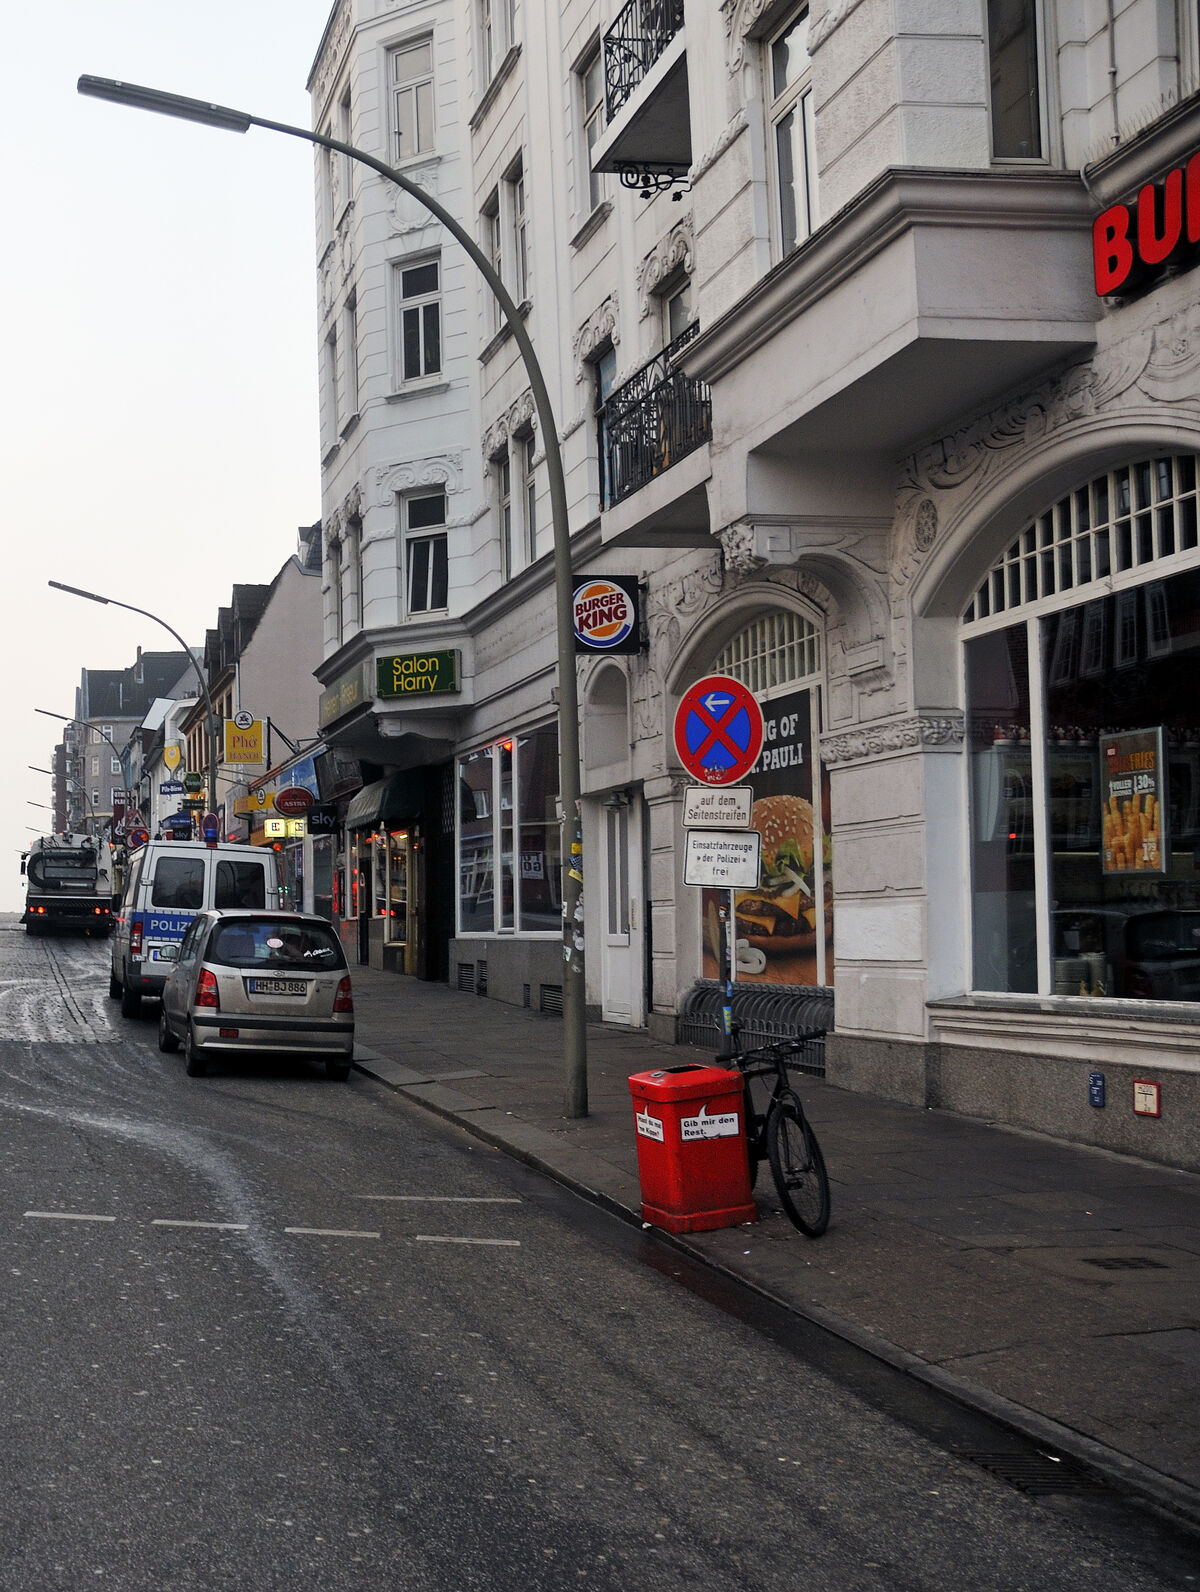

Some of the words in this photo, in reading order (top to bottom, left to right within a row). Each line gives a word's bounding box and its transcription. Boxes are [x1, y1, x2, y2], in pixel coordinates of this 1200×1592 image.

[575, 592, 625, 617] BURGER
[578, 603, 627, 633] KING
[392, 656, 439, 675] Salon
[393, 675, 438, 692] Harry
[780, 713, 798, 738] OF
[762, 742, 803, 772] PAULI
[701, 795, 714, 805] auf
[718, 795, 736, 806] dem
[311, 812, 336, 828] sky
[688, 809, 747, 820] Seitenstreifen
[692, 840, 753, 853] Einsatzfahrzeuge
[703, 854, 713, 862] der
[717, 854, 740, 863] Polizei
[712, 867, 729, 876] frei
[150, 919, 192, 932] POLIZ
[255, 981, 269, 991] HH
[273, 981, 287, 992] BJ
[683, 1120, 698, 1128] Gib
[701, 1118, 715, 1126] mir
[718, 1116, 735, 1124] den
[684, 1128, 707, 1137] Rest.
